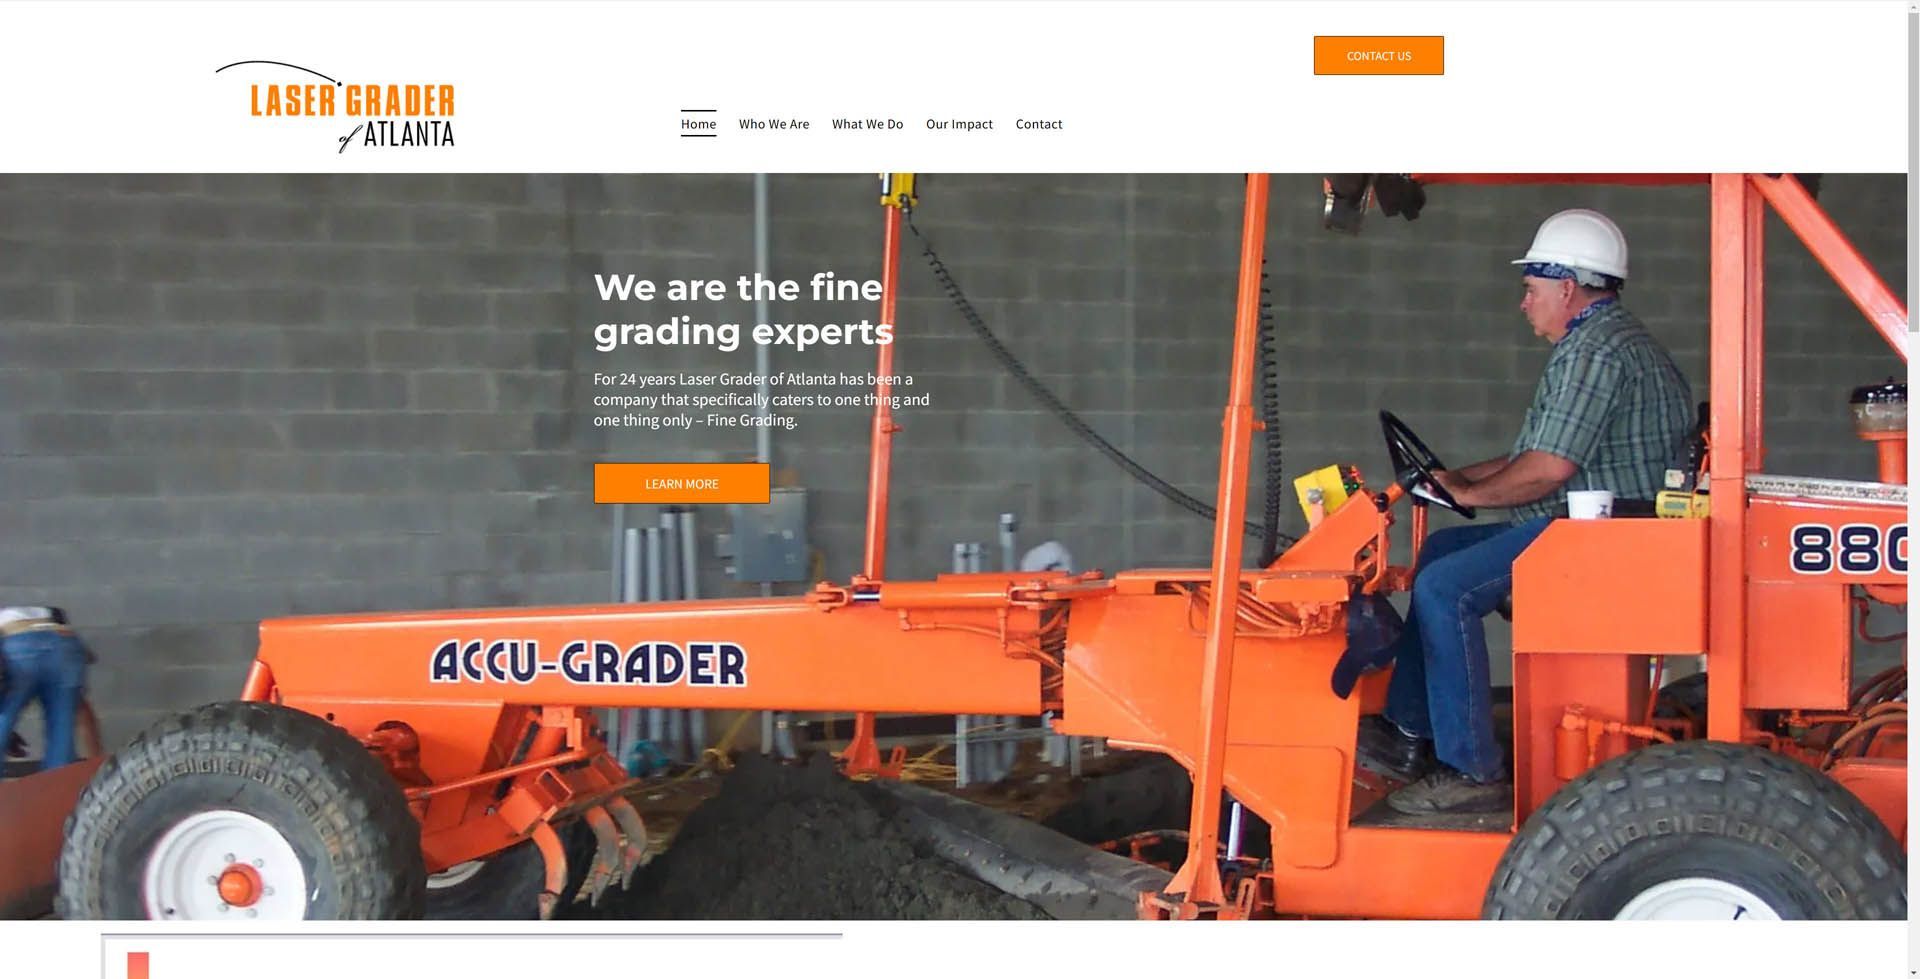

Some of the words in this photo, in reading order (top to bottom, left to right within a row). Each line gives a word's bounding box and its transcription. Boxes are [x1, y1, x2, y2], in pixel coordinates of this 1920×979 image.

[1347, 51, 1393, 62] CONTACT
[1397, 51, 1411, 62] US
[251, 84, 336, 117] LASER
[345, 84, 455, 117] GRADER
[681, 119, 717, 130] Home
[739, 118, 766, 130] Who
[768, 119, 787, 130] We
[789, 119, 810, 130] Are
[832, 118, 863, 130] What
[865, 119, 885, 130] We
[887, 119, 904, 130] Do
[926, 119, 949, 130] Our
[952, 119, 993, 133] Impact
[1015, 118, 1063, 130] Contact
[338, 122, 364, 154] of
[364, 120, 455, 147] ATLANTA
[431, 640, 747, 687] ACCU-GRADER
